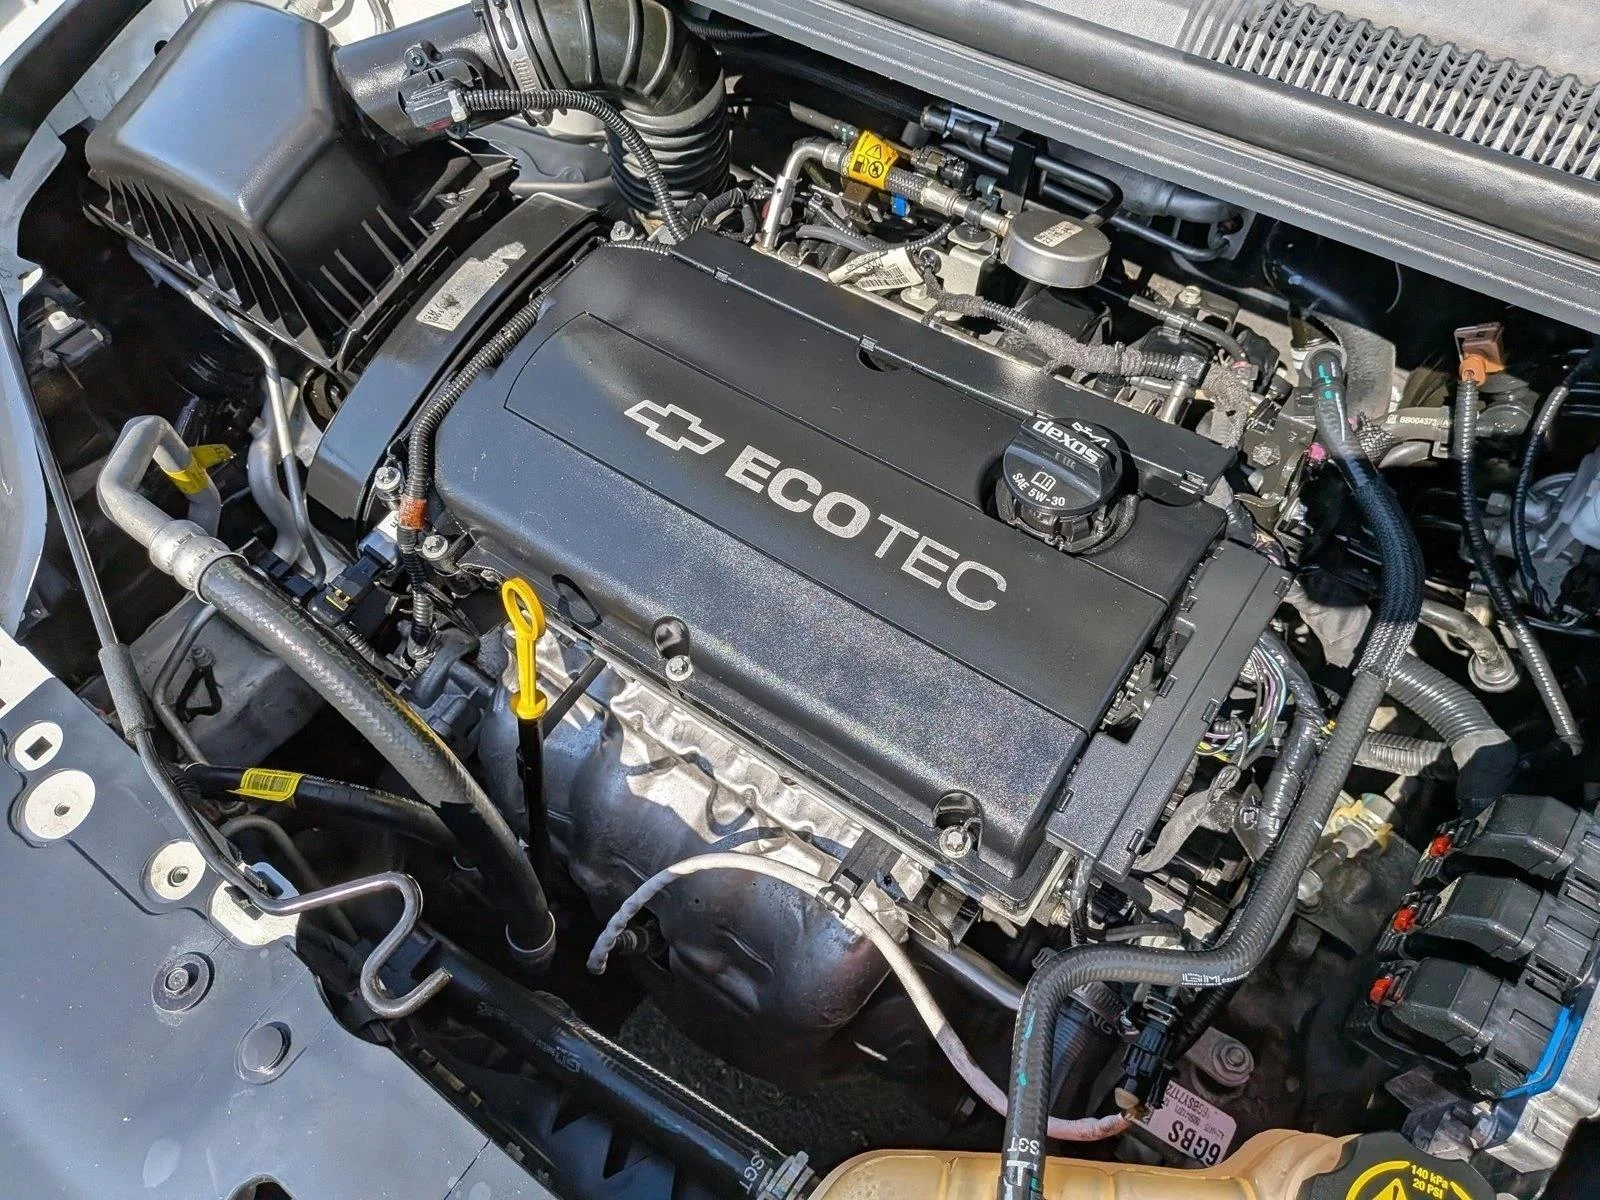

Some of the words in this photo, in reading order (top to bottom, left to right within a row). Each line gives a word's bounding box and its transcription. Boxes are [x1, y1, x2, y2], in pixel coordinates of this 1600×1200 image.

[1032, 419, 1102, 463] dexos
[1012, 472, 1030, 491] SAE
[1028, 488, 1066, 507] 5W-30
[724, 444, 1008, 611] ECOTEC
[1006, 1136, 1040, 1156] SGT
[1168, 1120, 1221, 1166] 6GBS
[739, 1154, 765, 1195] SGT
[1411, 1164, 1429, 1180] 140
[1430, 1172, 1449, 1190] kPa
[1412, 1178, 1426, 1191] 20
[1427, 1183, 1444, 1200] PSI
